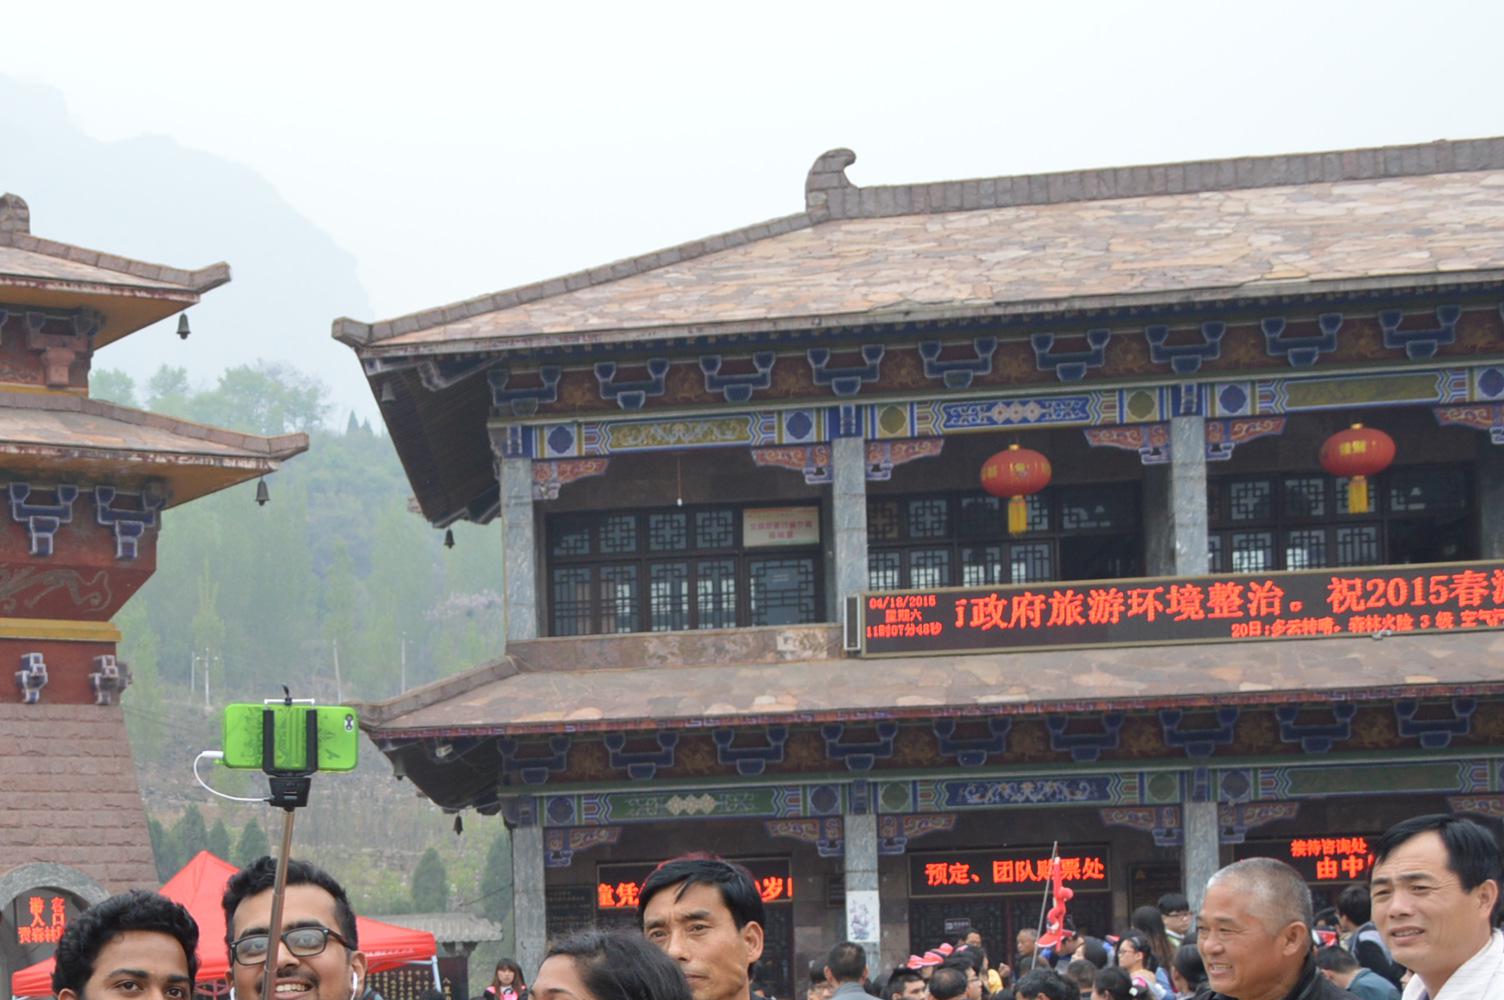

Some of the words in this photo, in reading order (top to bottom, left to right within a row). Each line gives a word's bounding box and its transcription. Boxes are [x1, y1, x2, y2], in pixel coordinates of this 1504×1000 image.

[885, 608, 923, 624] 星期六
[1290, 837, 1368, 858] 接待咨询处
